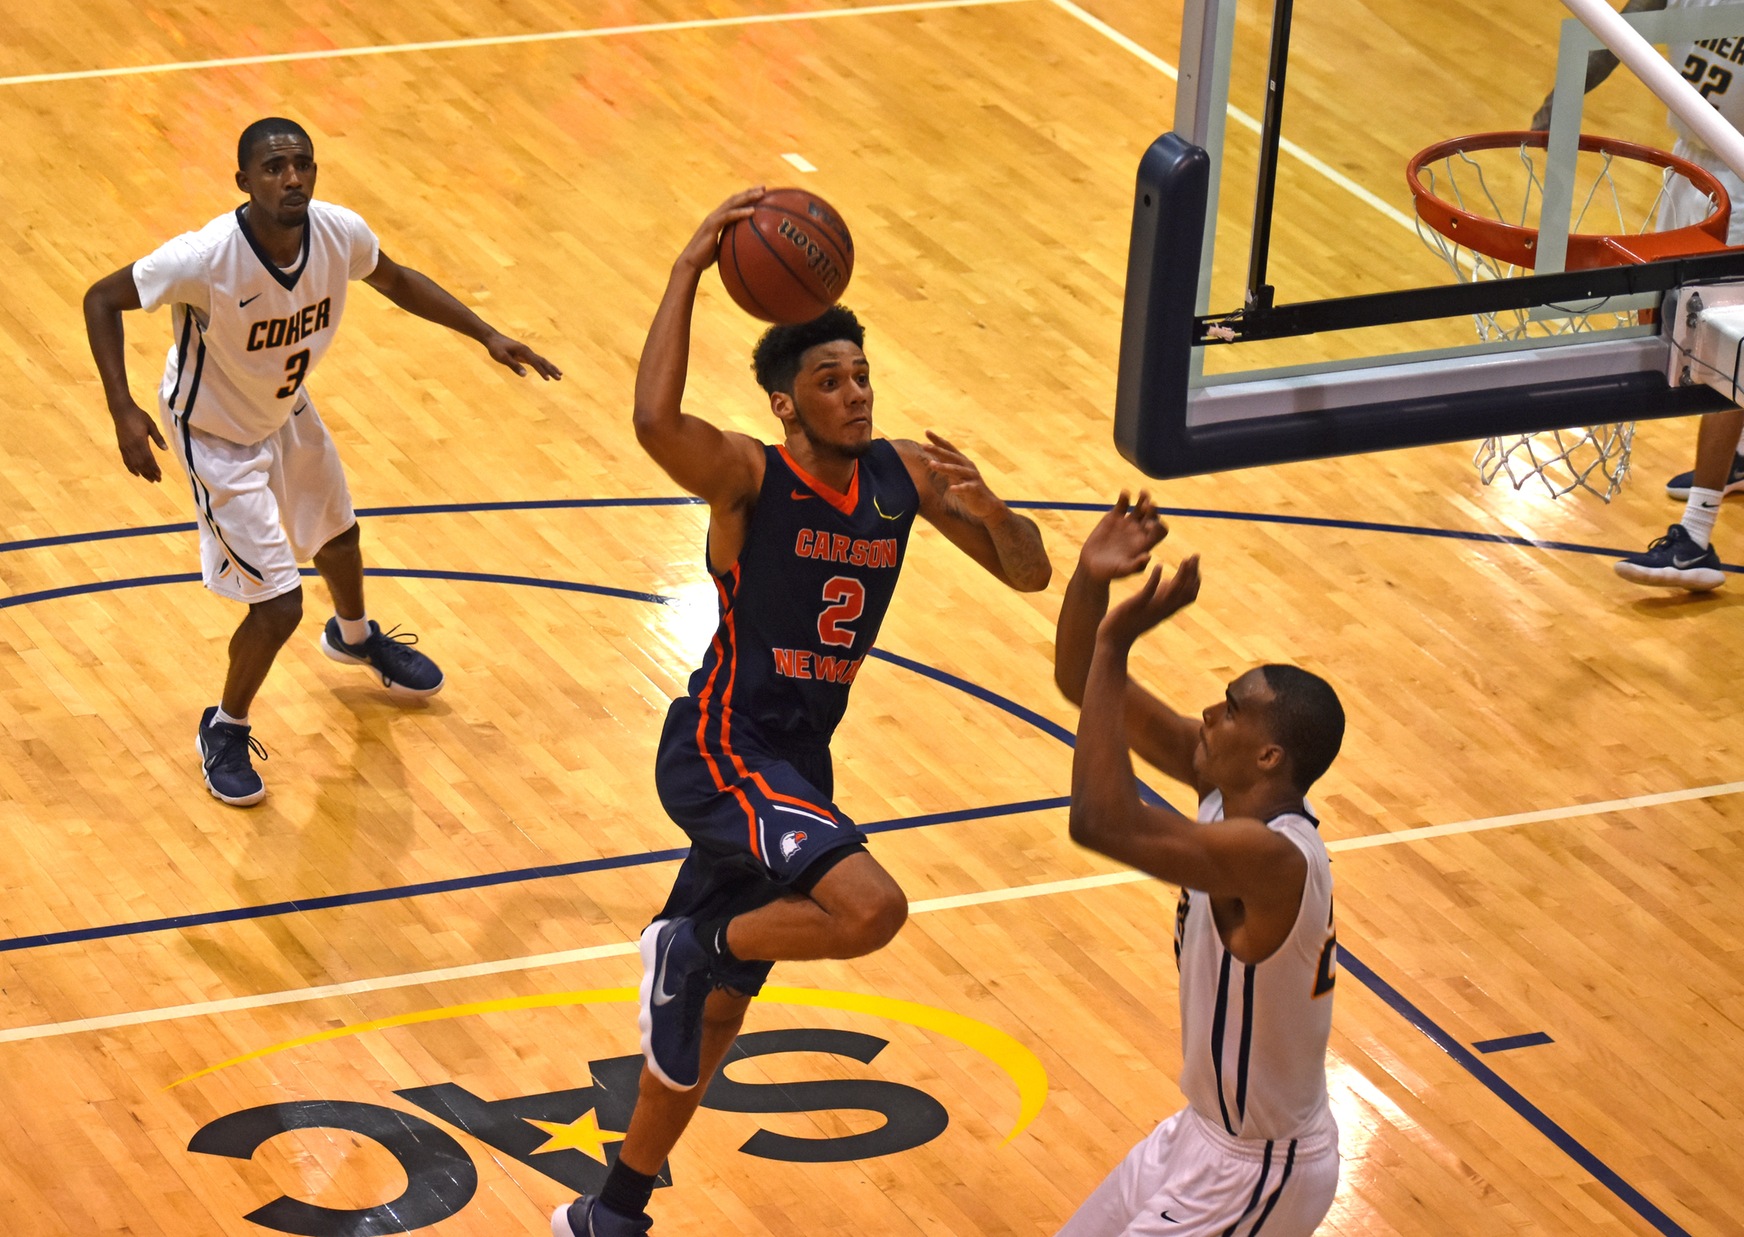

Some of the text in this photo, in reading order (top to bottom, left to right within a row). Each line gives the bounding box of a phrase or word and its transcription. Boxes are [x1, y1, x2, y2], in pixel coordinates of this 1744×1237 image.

[246, 296, 331, 351] COKER
[275, 347, 310, 399] 3
[795, 528, 897, 568] CARSON
[817, 575, 866, 648] 2
